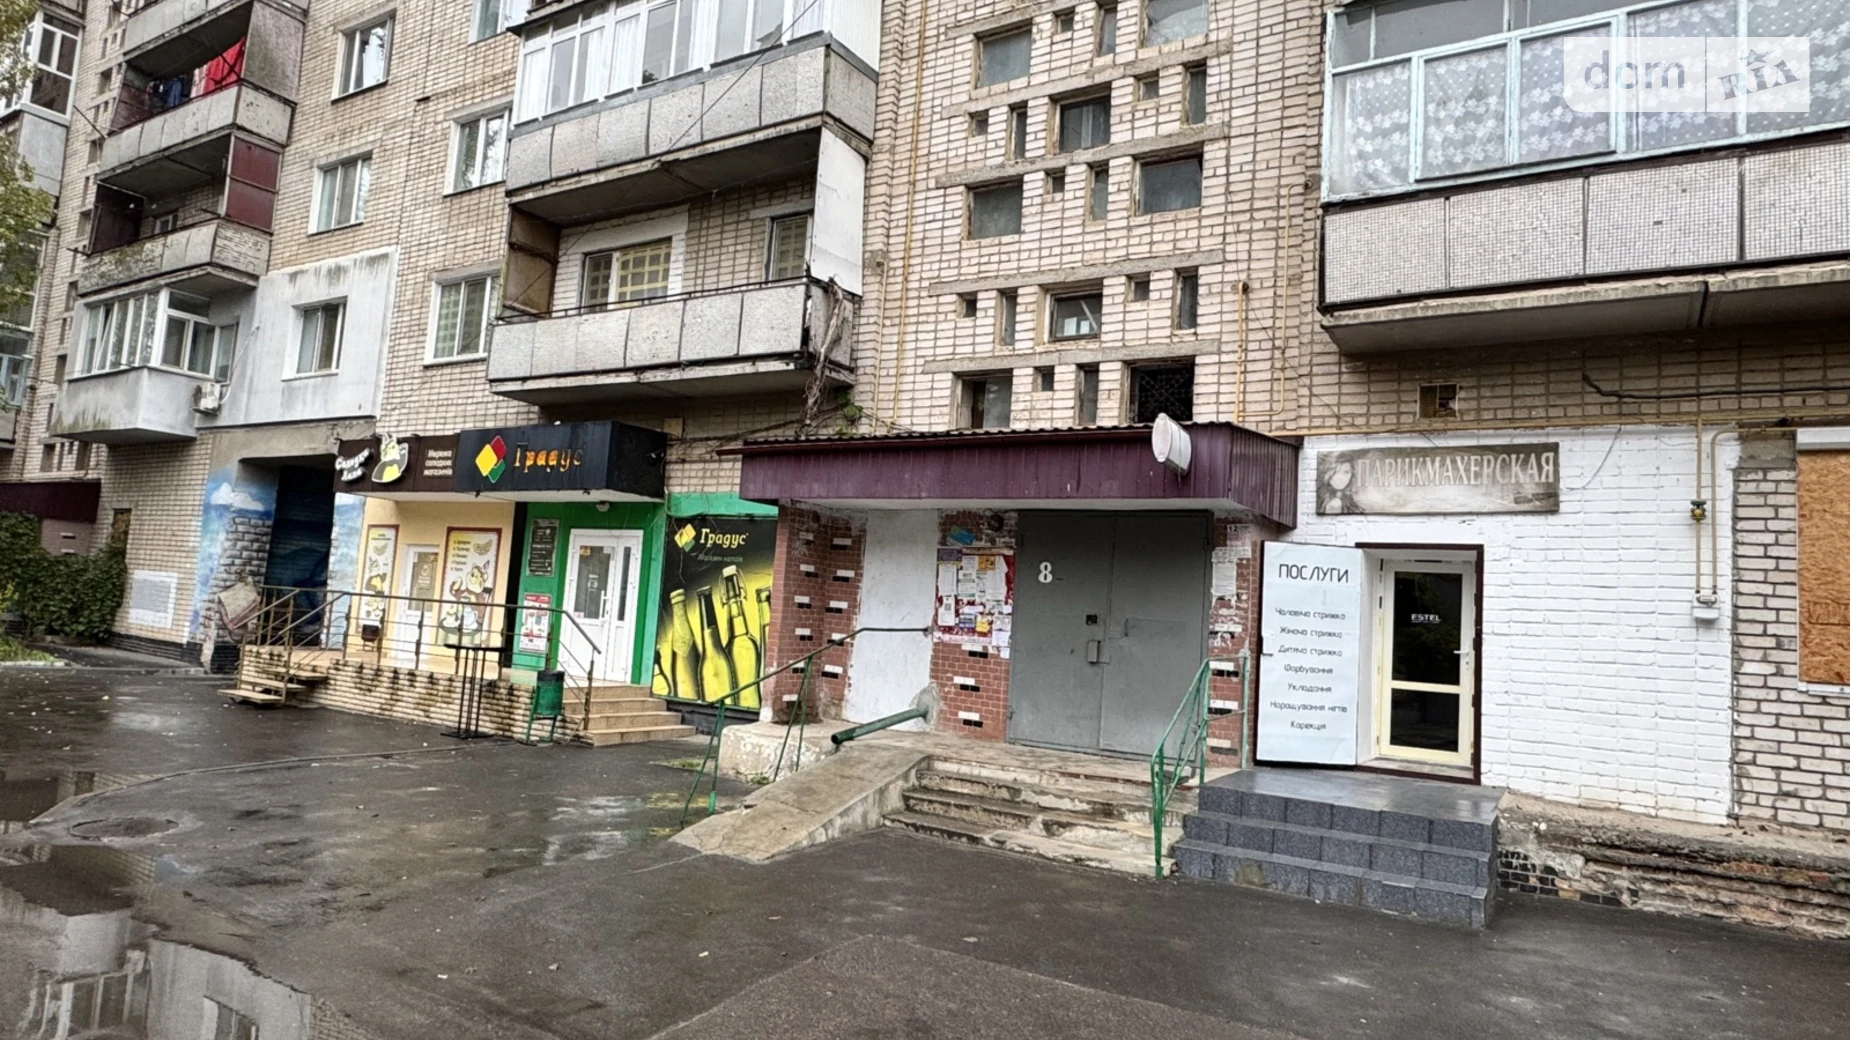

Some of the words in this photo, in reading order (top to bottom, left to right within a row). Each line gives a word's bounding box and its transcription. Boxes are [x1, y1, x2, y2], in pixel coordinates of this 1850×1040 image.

[1357, 452, 1555, 487] ПАРИКМАХЕРСКАЯ
[700, 528, 746, 548] Градус
[1038, 562, 1053, 583] 8
[1278, 563, 1349, 583] ПОСЛУГИ
[1313, 612, 1346, 620] стрижка
[1411, 613, 1441, 621] ESTEL
[1280, 626, 1308, 636] Жіноча
[1310, 630, 1342, 638] стрижка
[1278, 644, 1307, 654] Дитяча
[1310, 648, 1343, 657] стрижка
[1284, 664, 1333, 675] Фарбування
[1287, 682, 1332, 693] Укладання
[1270, 701, 1326, 712] Нарощування
[1290, 721, 1326, 731] Корекція
